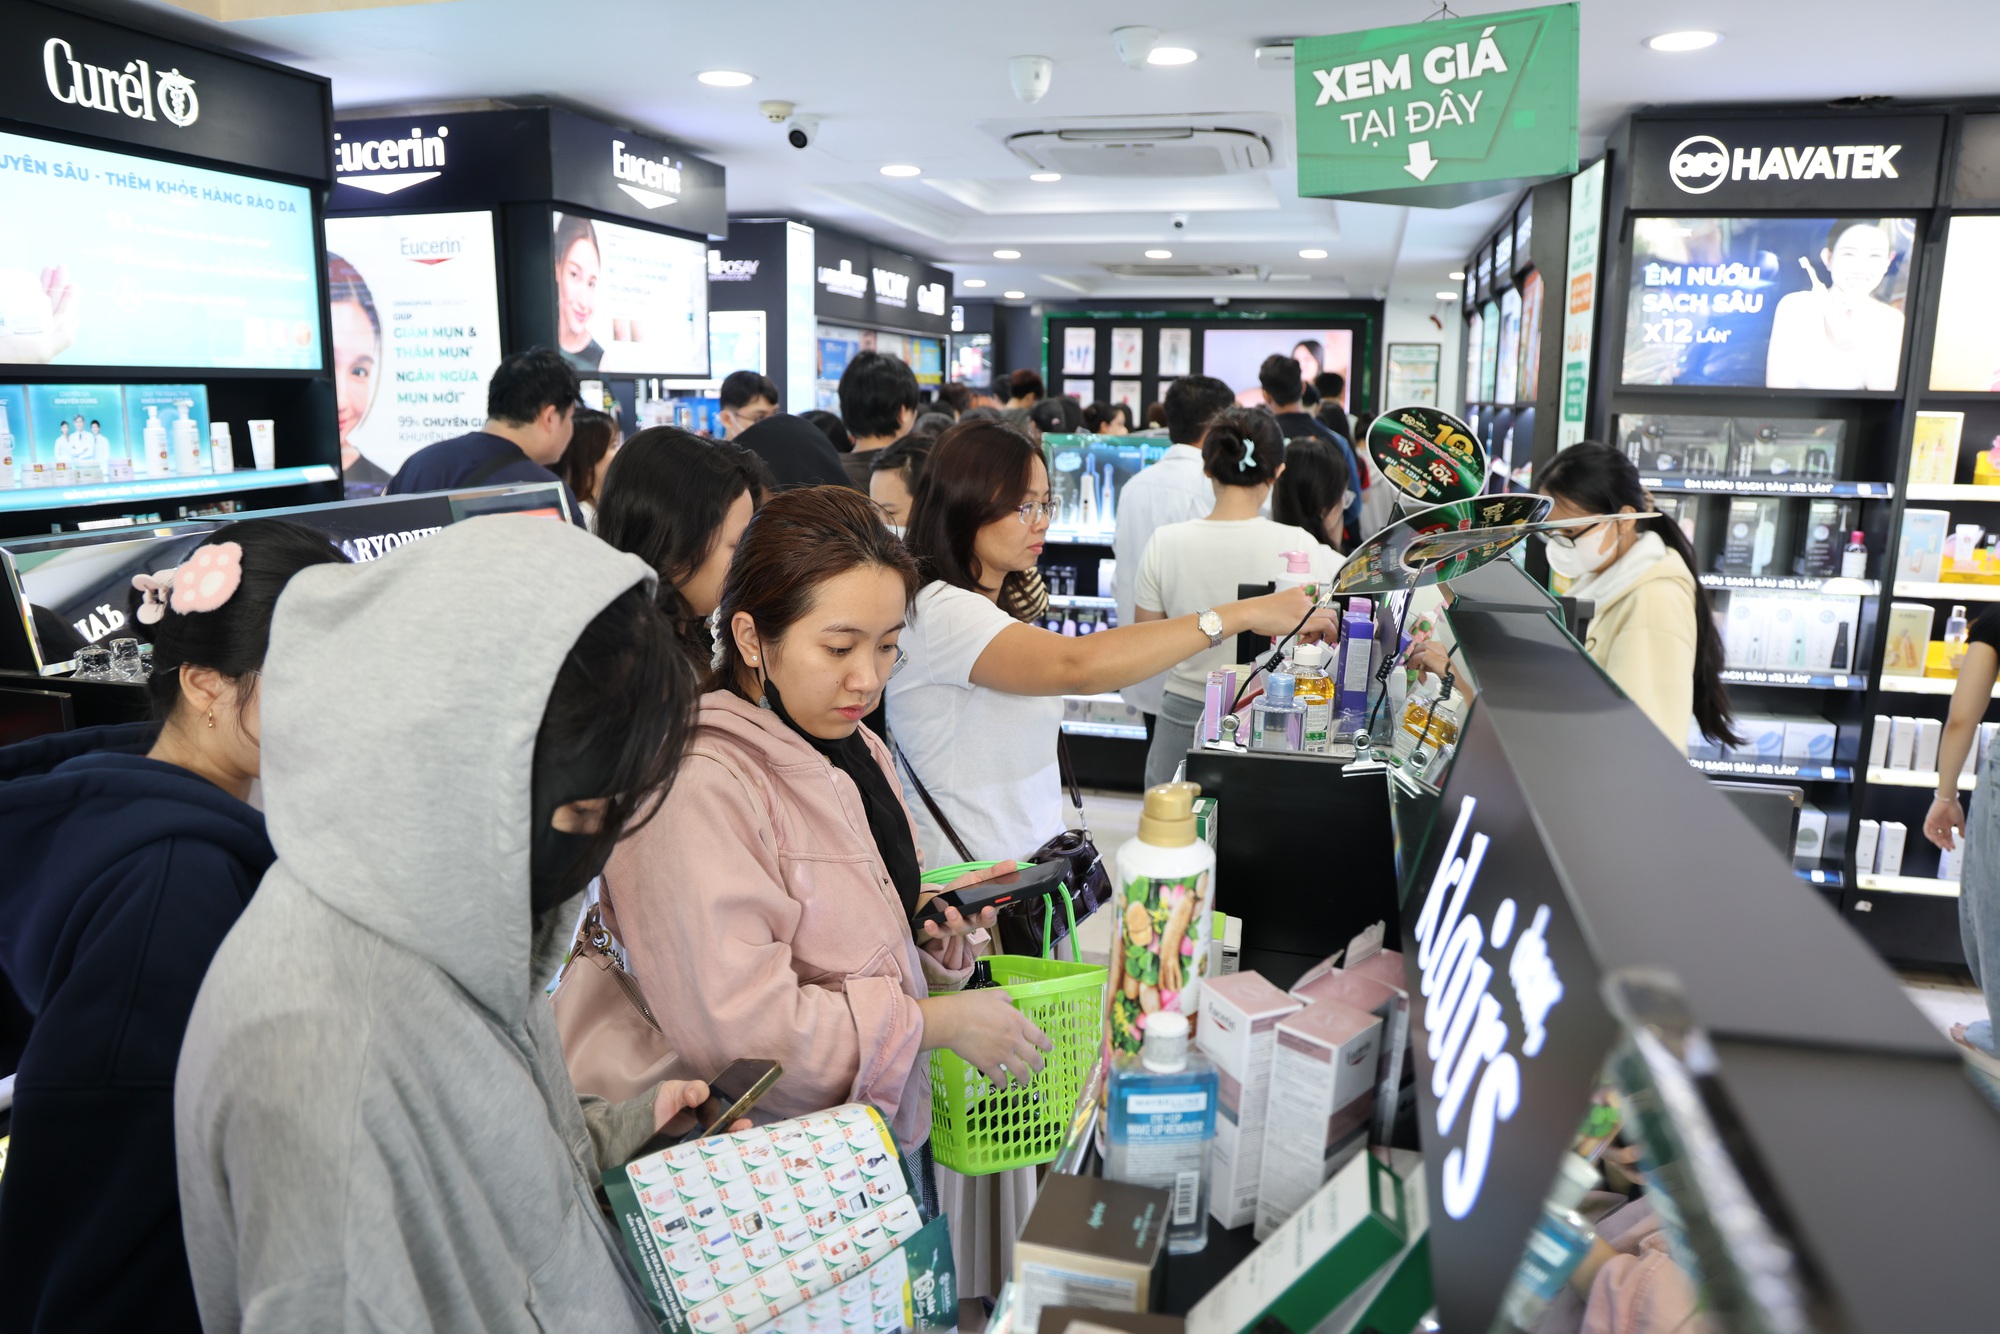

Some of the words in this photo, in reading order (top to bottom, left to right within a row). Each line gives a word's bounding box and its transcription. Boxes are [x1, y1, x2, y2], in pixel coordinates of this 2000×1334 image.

[1312, 53, 1412, 106] XEM
[1423, 25, 1508, 85] GIÁ
[43, 37, 157, 122] Curél
[1340, 106, 1396, 148] TẠI
[1405, 88, 1483, 134] ĐÂY
[612, 139, 681, 195] Eucerin
[1732, 145, 1902, 181] HAVATEK
[54, 163, 89, 182] SÂU
[105, 171, 151, 192] THÊM
[203, 186, 243, 206] HÀNG
[247, 193, 274, 211] RÀO
[279, 201, 297, 213] DA
[401, 237, 461, 256] Eucerin
[1645, 262, 1682, 286] ÊM
[1642, 293, 1709, 317] SẠCH
[1712, 290, 1764, 313] SÂU
[433, 327, 463, 341] MỤN
[468, 326, 476, 337] &
[1642, 318, 1693, 343] x12
[397, 393, 428, 405] MỤN
[423, 415, 467, 426] CHUYÊN
[1397, 442, 1415, 457] 1K
[1434, 424, 1474, 456] 10
[1385, 457, 1397, 466] 8H
[1405, 469, 1420, 481] 12H
[1427, 483, 1442, 496] 18H
[1428, 462, 1454, 487] 10K
[876, 1122, 885, 1132] 8H
[640, 1232, 653, 1250] HẠN
